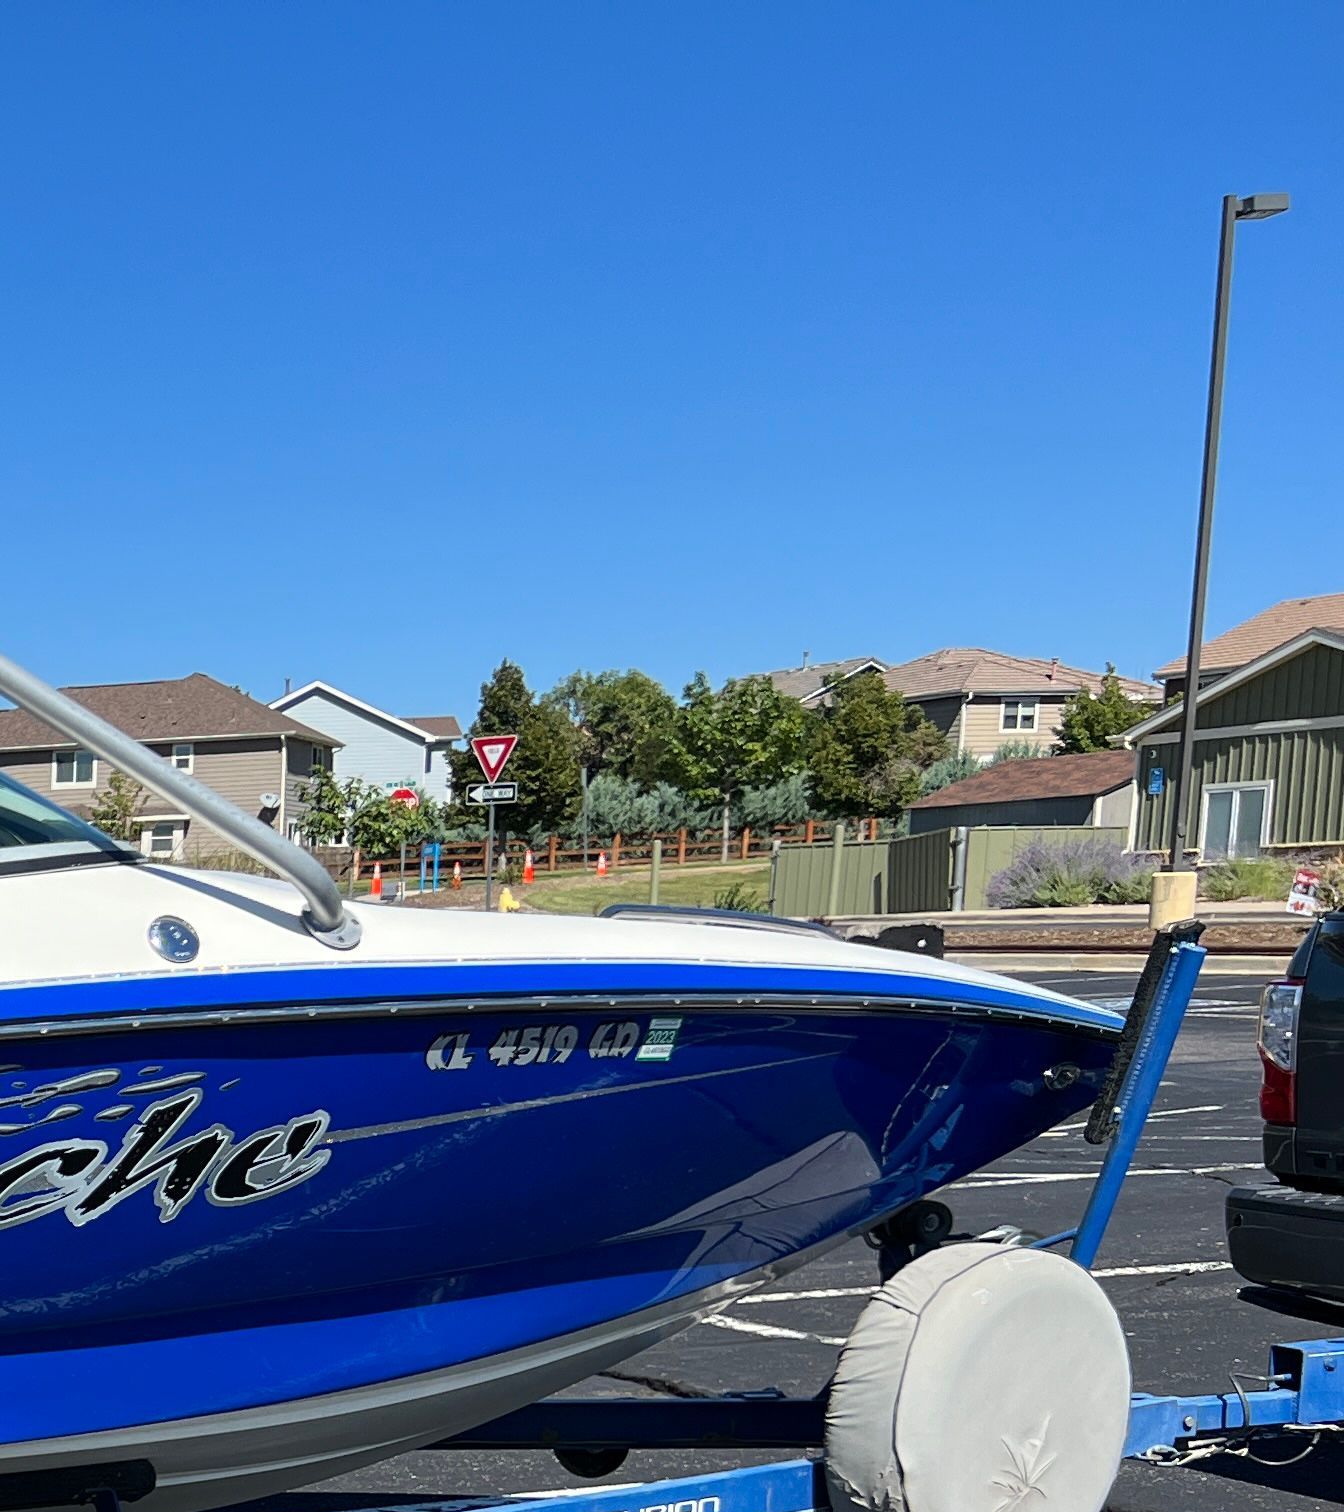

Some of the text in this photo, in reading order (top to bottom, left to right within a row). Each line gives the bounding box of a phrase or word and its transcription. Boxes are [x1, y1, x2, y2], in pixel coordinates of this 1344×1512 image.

[425, 1032, 473, 1071] CL
[488, 1025, 579, 1067] 4519
[645, 1030, 676, 1045] 2023
